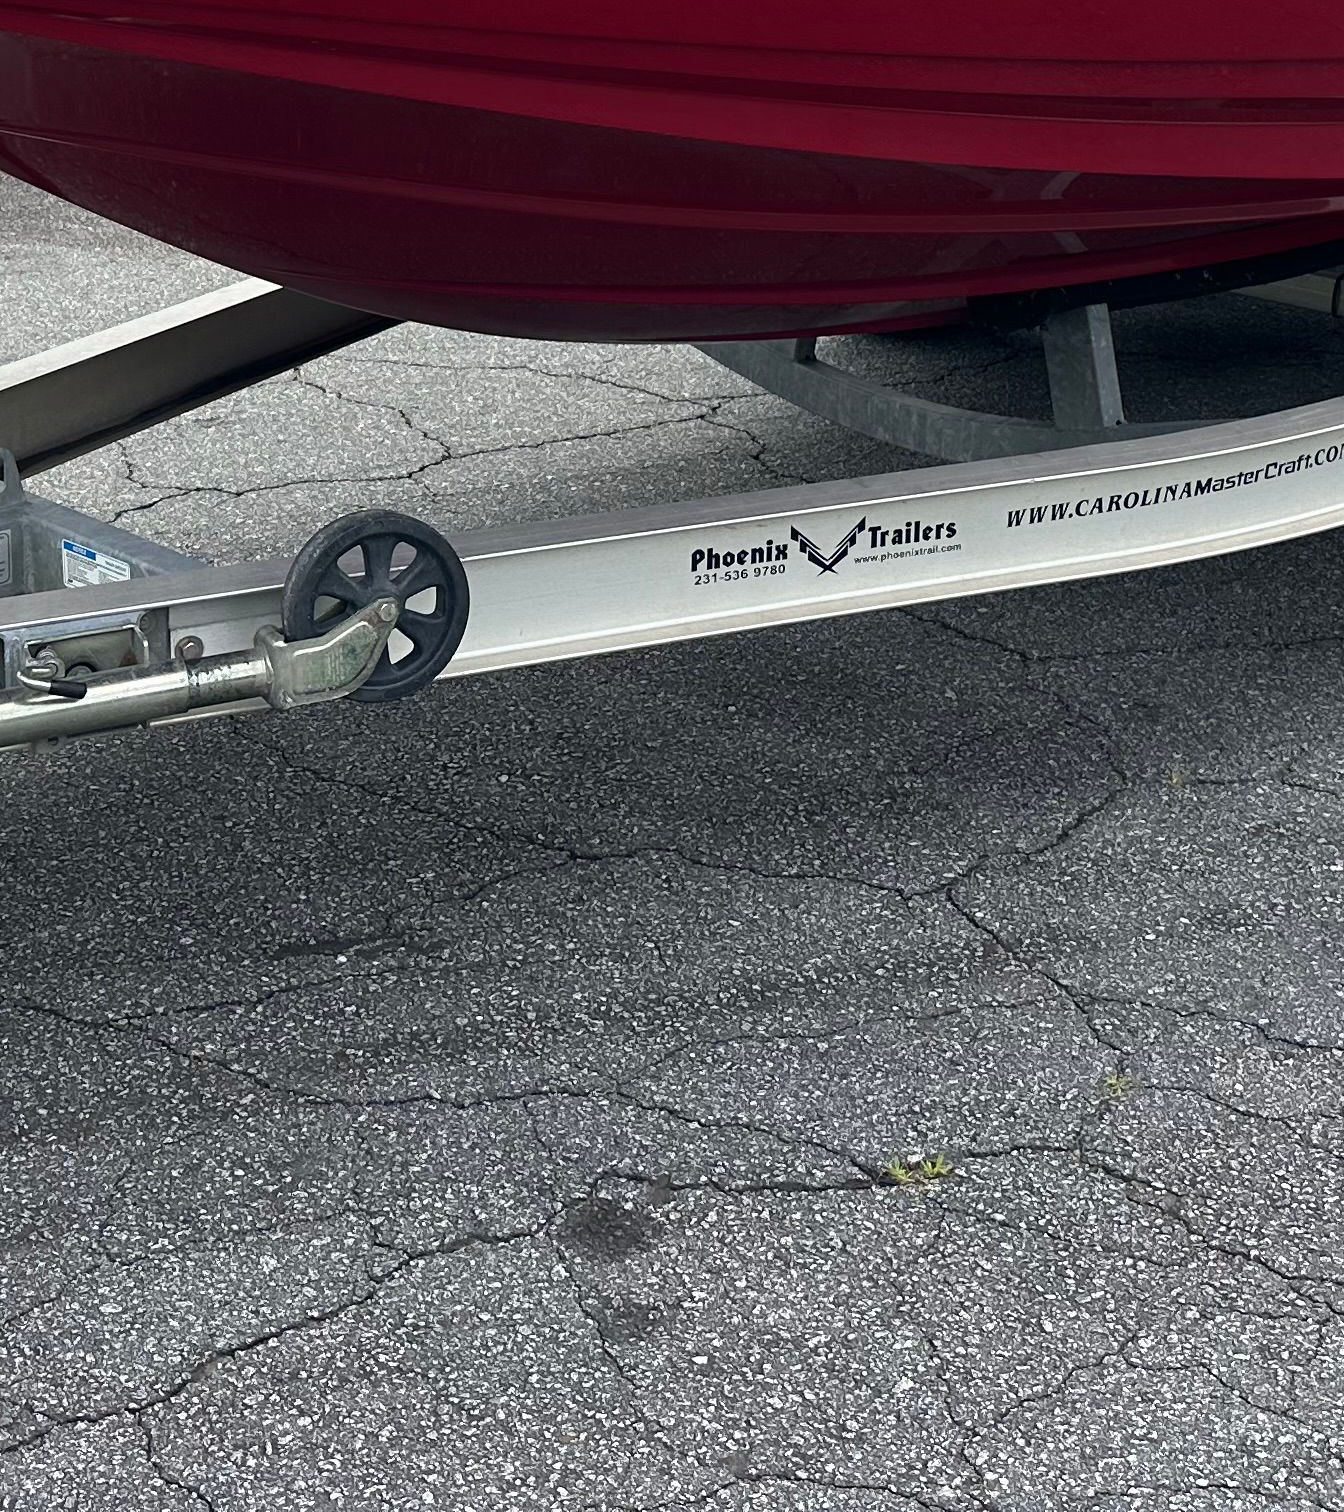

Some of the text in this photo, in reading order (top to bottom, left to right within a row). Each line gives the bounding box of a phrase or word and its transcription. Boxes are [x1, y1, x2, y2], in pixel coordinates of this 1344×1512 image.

[690, 520, 957, 573] Phoenix Trailers
[853, 541, 962, 565] www.phoenixtrail.com
[694, 563, 787, 586] 231-536 9780
